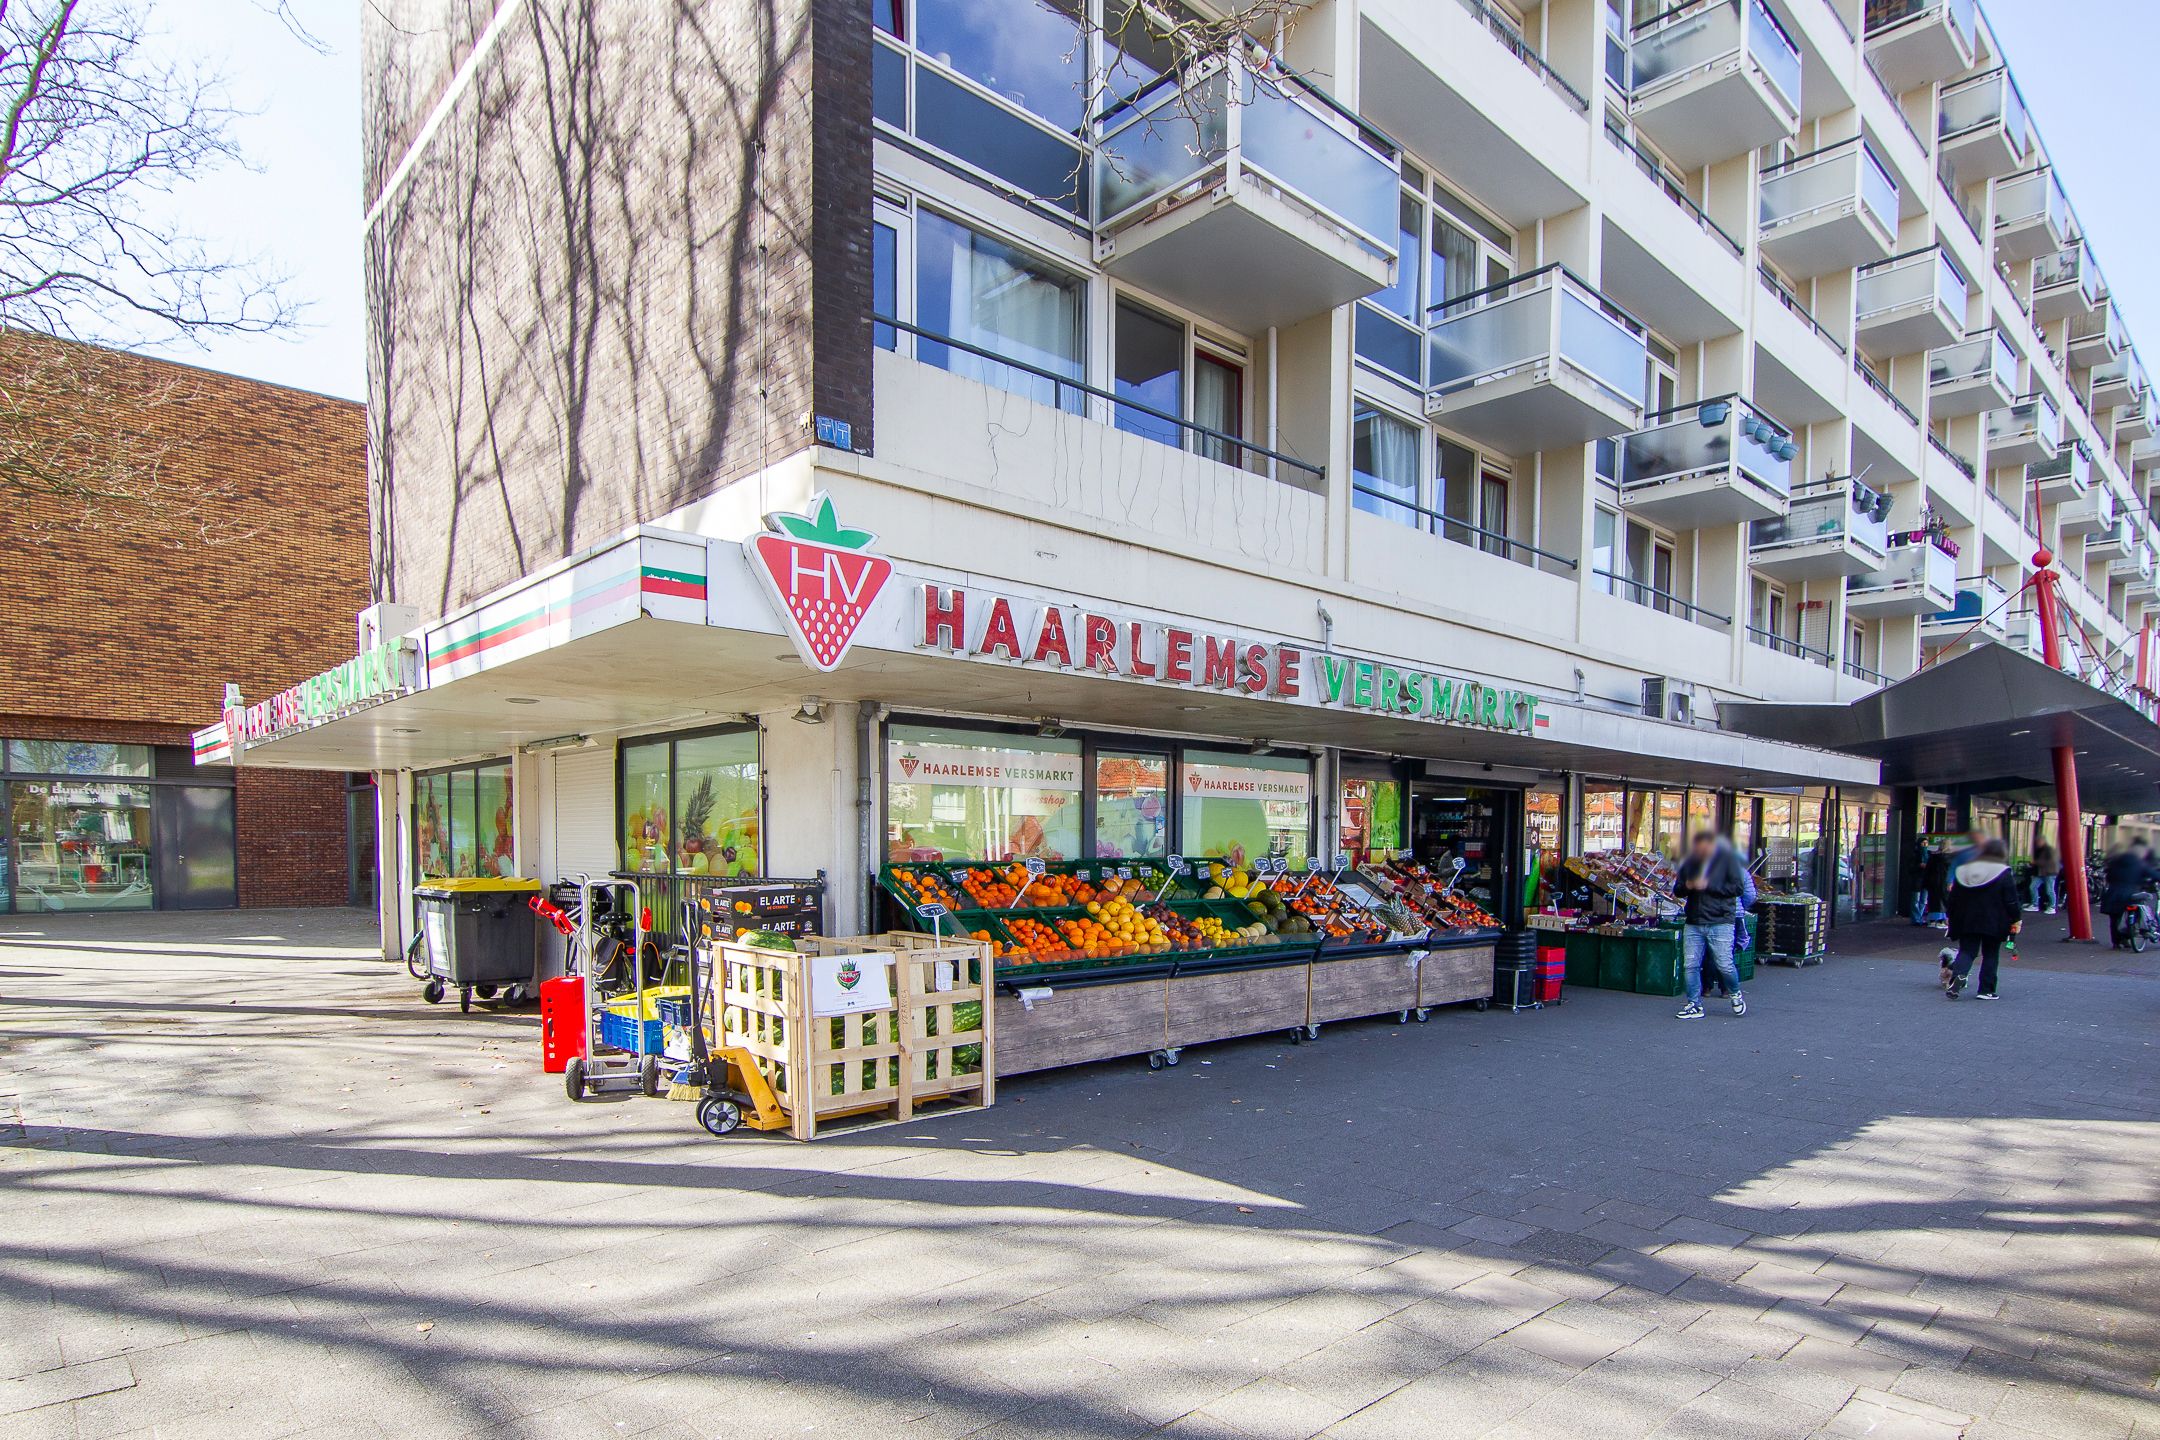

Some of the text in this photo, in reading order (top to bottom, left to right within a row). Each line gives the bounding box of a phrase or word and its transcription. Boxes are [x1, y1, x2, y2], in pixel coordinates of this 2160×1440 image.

[790, 546, 873, 604] HV
[918, 584, 1539, 737] HAARLEMSE VERSMARKT
[238, 635, 402, 745] HAARLEMSE VERSMARKT
[923, 763, 1074, 782] HAARLEMSE VERSMARKT
[1204, 779, 1304, 795] HAARLEMSE VERSMARKT
[760, 894, 796, 906] EL ARTE
[773, 921, 796, 932] ARTE
